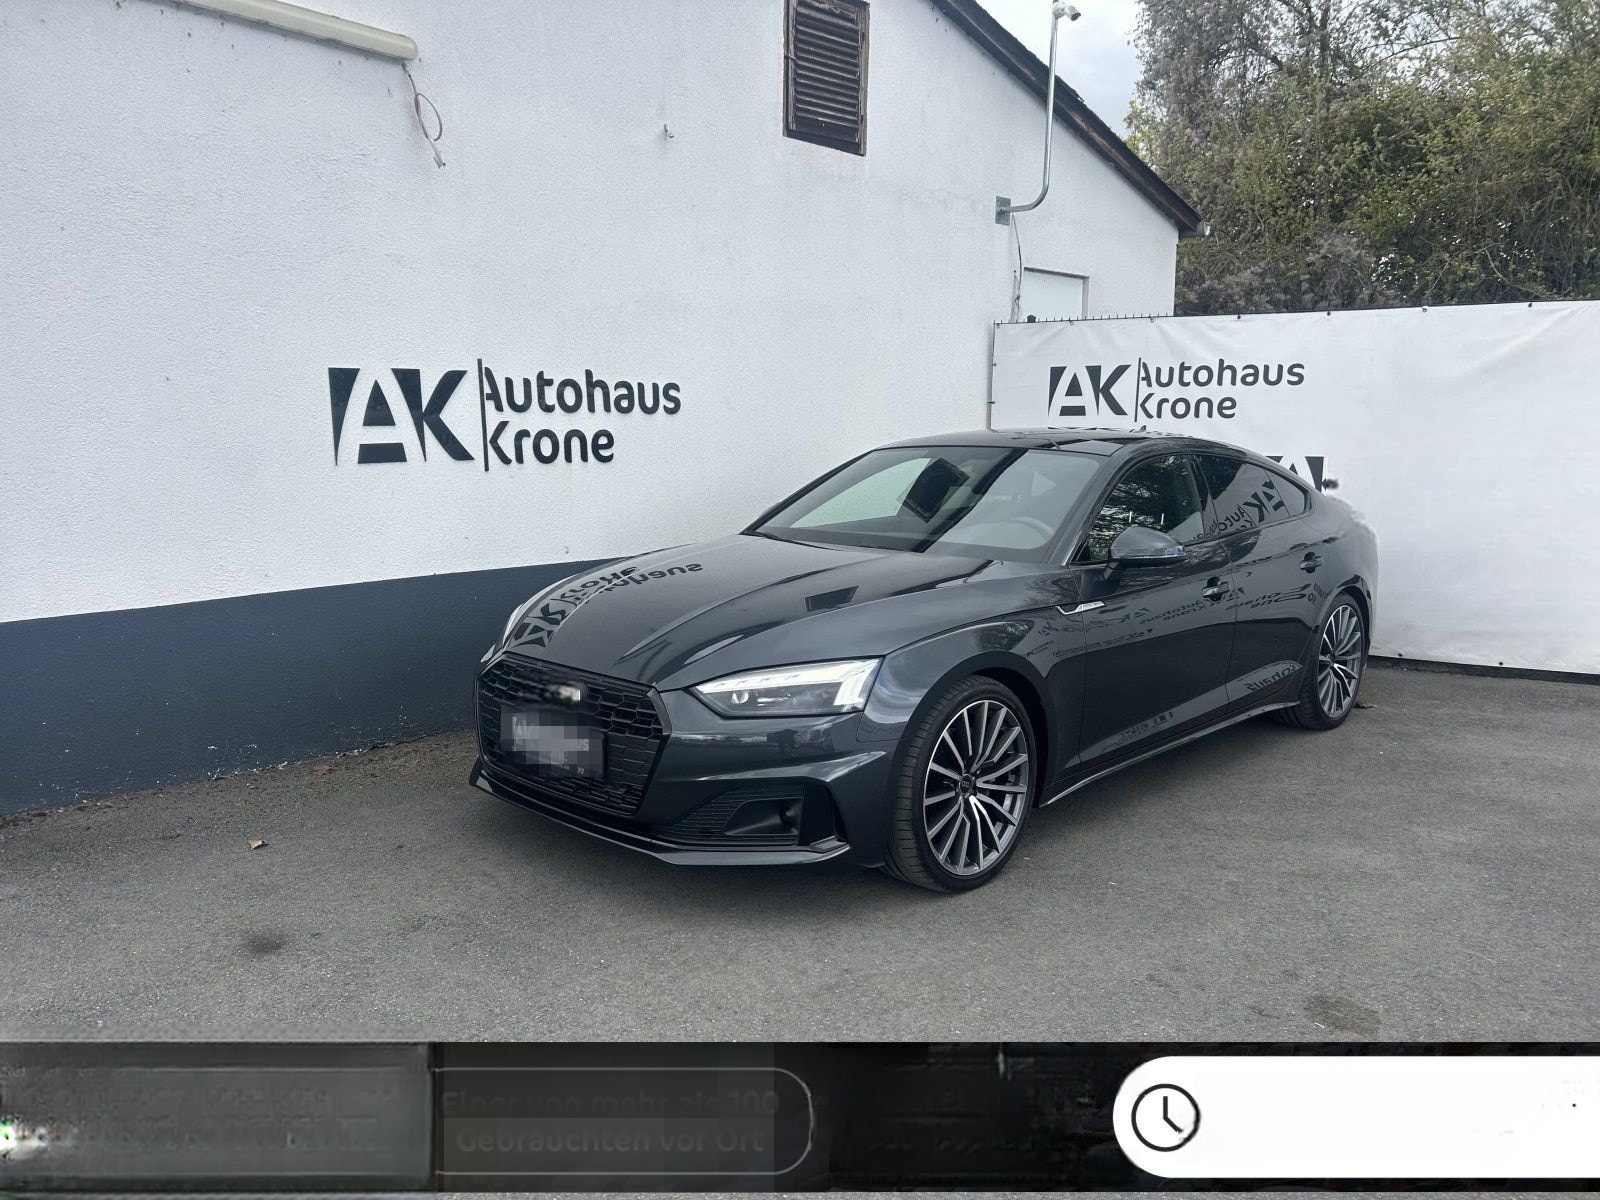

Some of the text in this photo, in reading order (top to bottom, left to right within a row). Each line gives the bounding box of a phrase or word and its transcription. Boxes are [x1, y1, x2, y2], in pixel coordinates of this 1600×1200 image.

[484, 366, 681, 415] Autohaus
[1048, 364, 1132, 417] AK
[1140, 358, 1305, 388] Autohaus
[327, 367, 475, 466] AK
[1138, 392, 1237, 419] Krone
[488, 420, 615, 465] Krone
